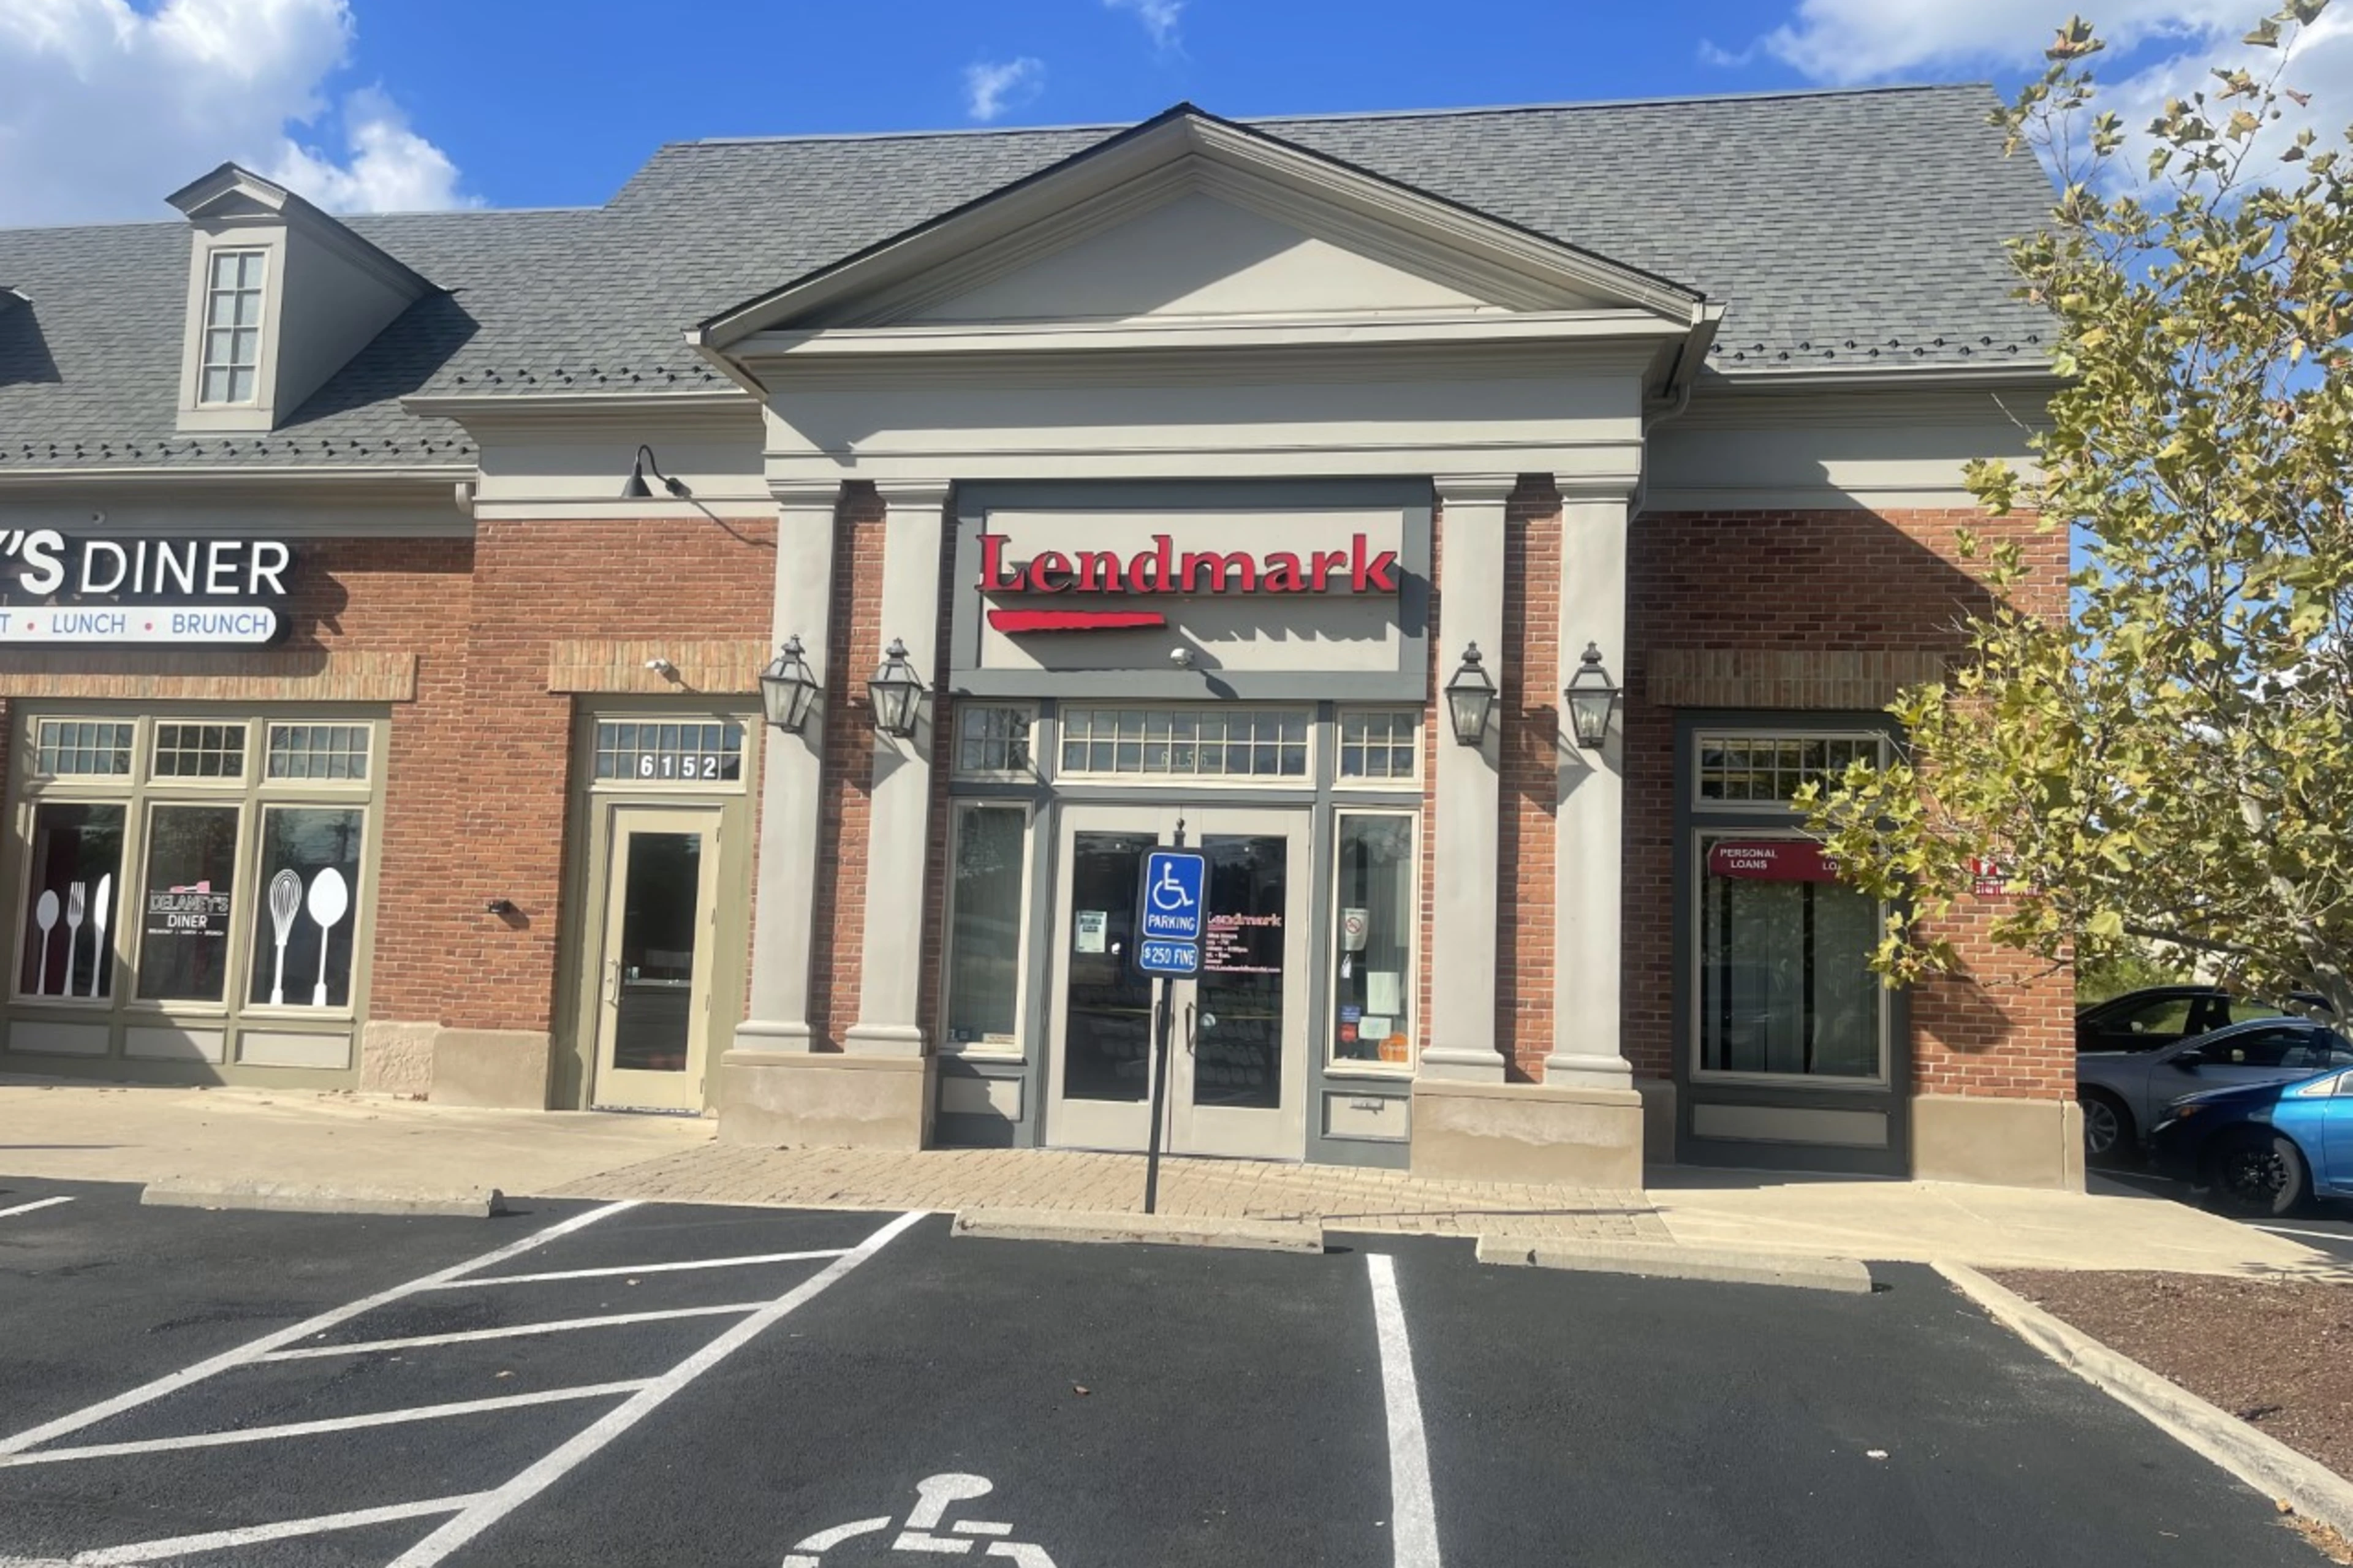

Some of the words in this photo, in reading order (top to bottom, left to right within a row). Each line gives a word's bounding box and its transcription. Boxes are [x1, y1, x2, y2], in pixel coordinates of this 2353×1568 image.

[80, 540, 290, 594] DINER
[974, 534, 1398, 593] Lendmark
[52, 614, 126, 634] LUNCH
[172, 615, 268, 635] BRUNCH
[641, 755, 716, 777] 6152
[1720, 849, 1777, 858] PERSONAL
[1730, 860, 1767, 869] LOANS
[167, 915, 208, 928] DINER
[1148, 914, 1195, 931] PARKING
[1174, 948, 1195, 966] FINE
